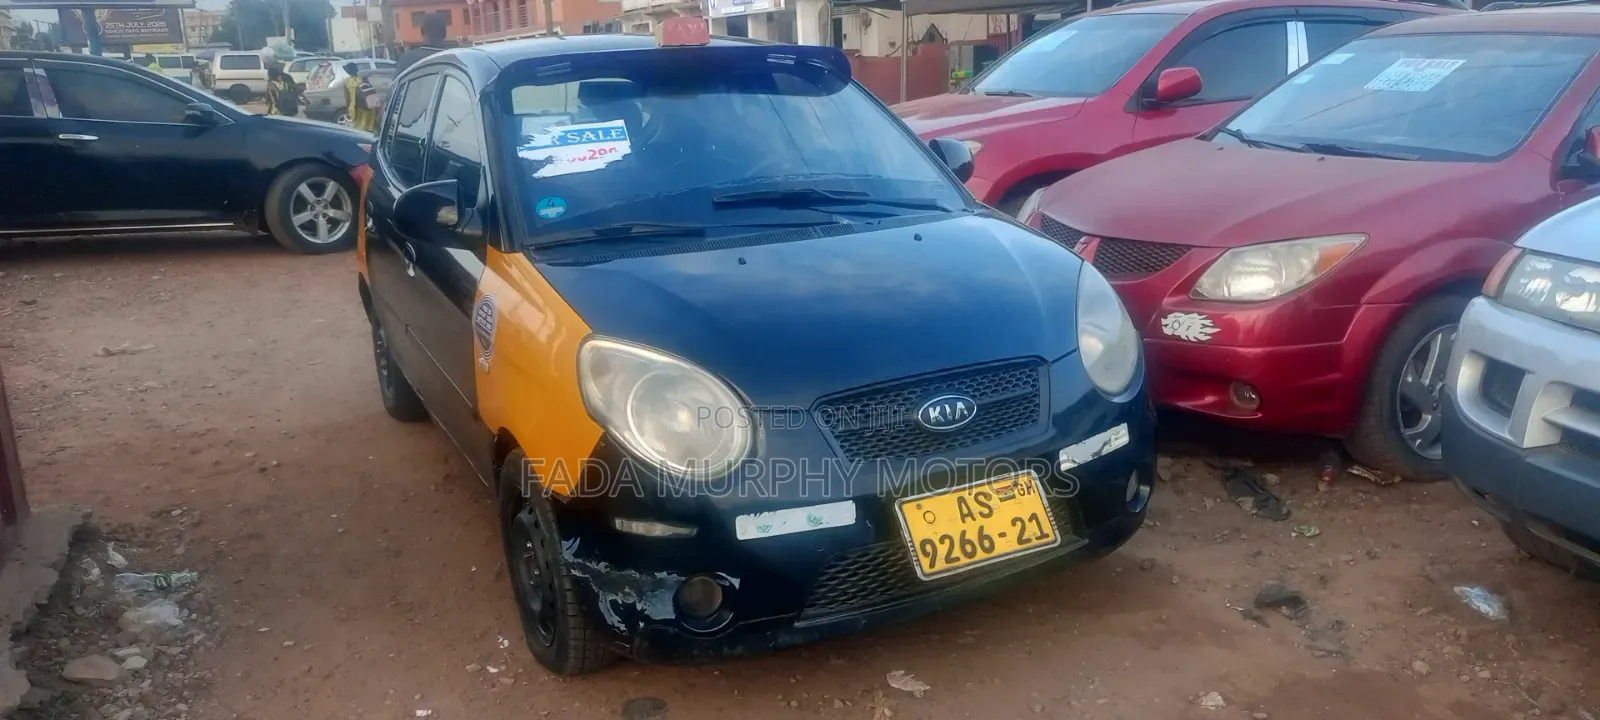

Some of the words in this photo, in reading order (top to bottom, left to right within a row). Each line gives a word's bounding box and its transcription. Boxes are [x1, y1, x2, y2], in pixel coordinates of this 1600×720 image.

[567, 128, 625, 143] SALE
[928, 401, 968, 422] KIA
[956, 491, 994, 524] AS
[1017, 480, 1036, 497] GH
[919, 512, 1050, 569] 9266-21
